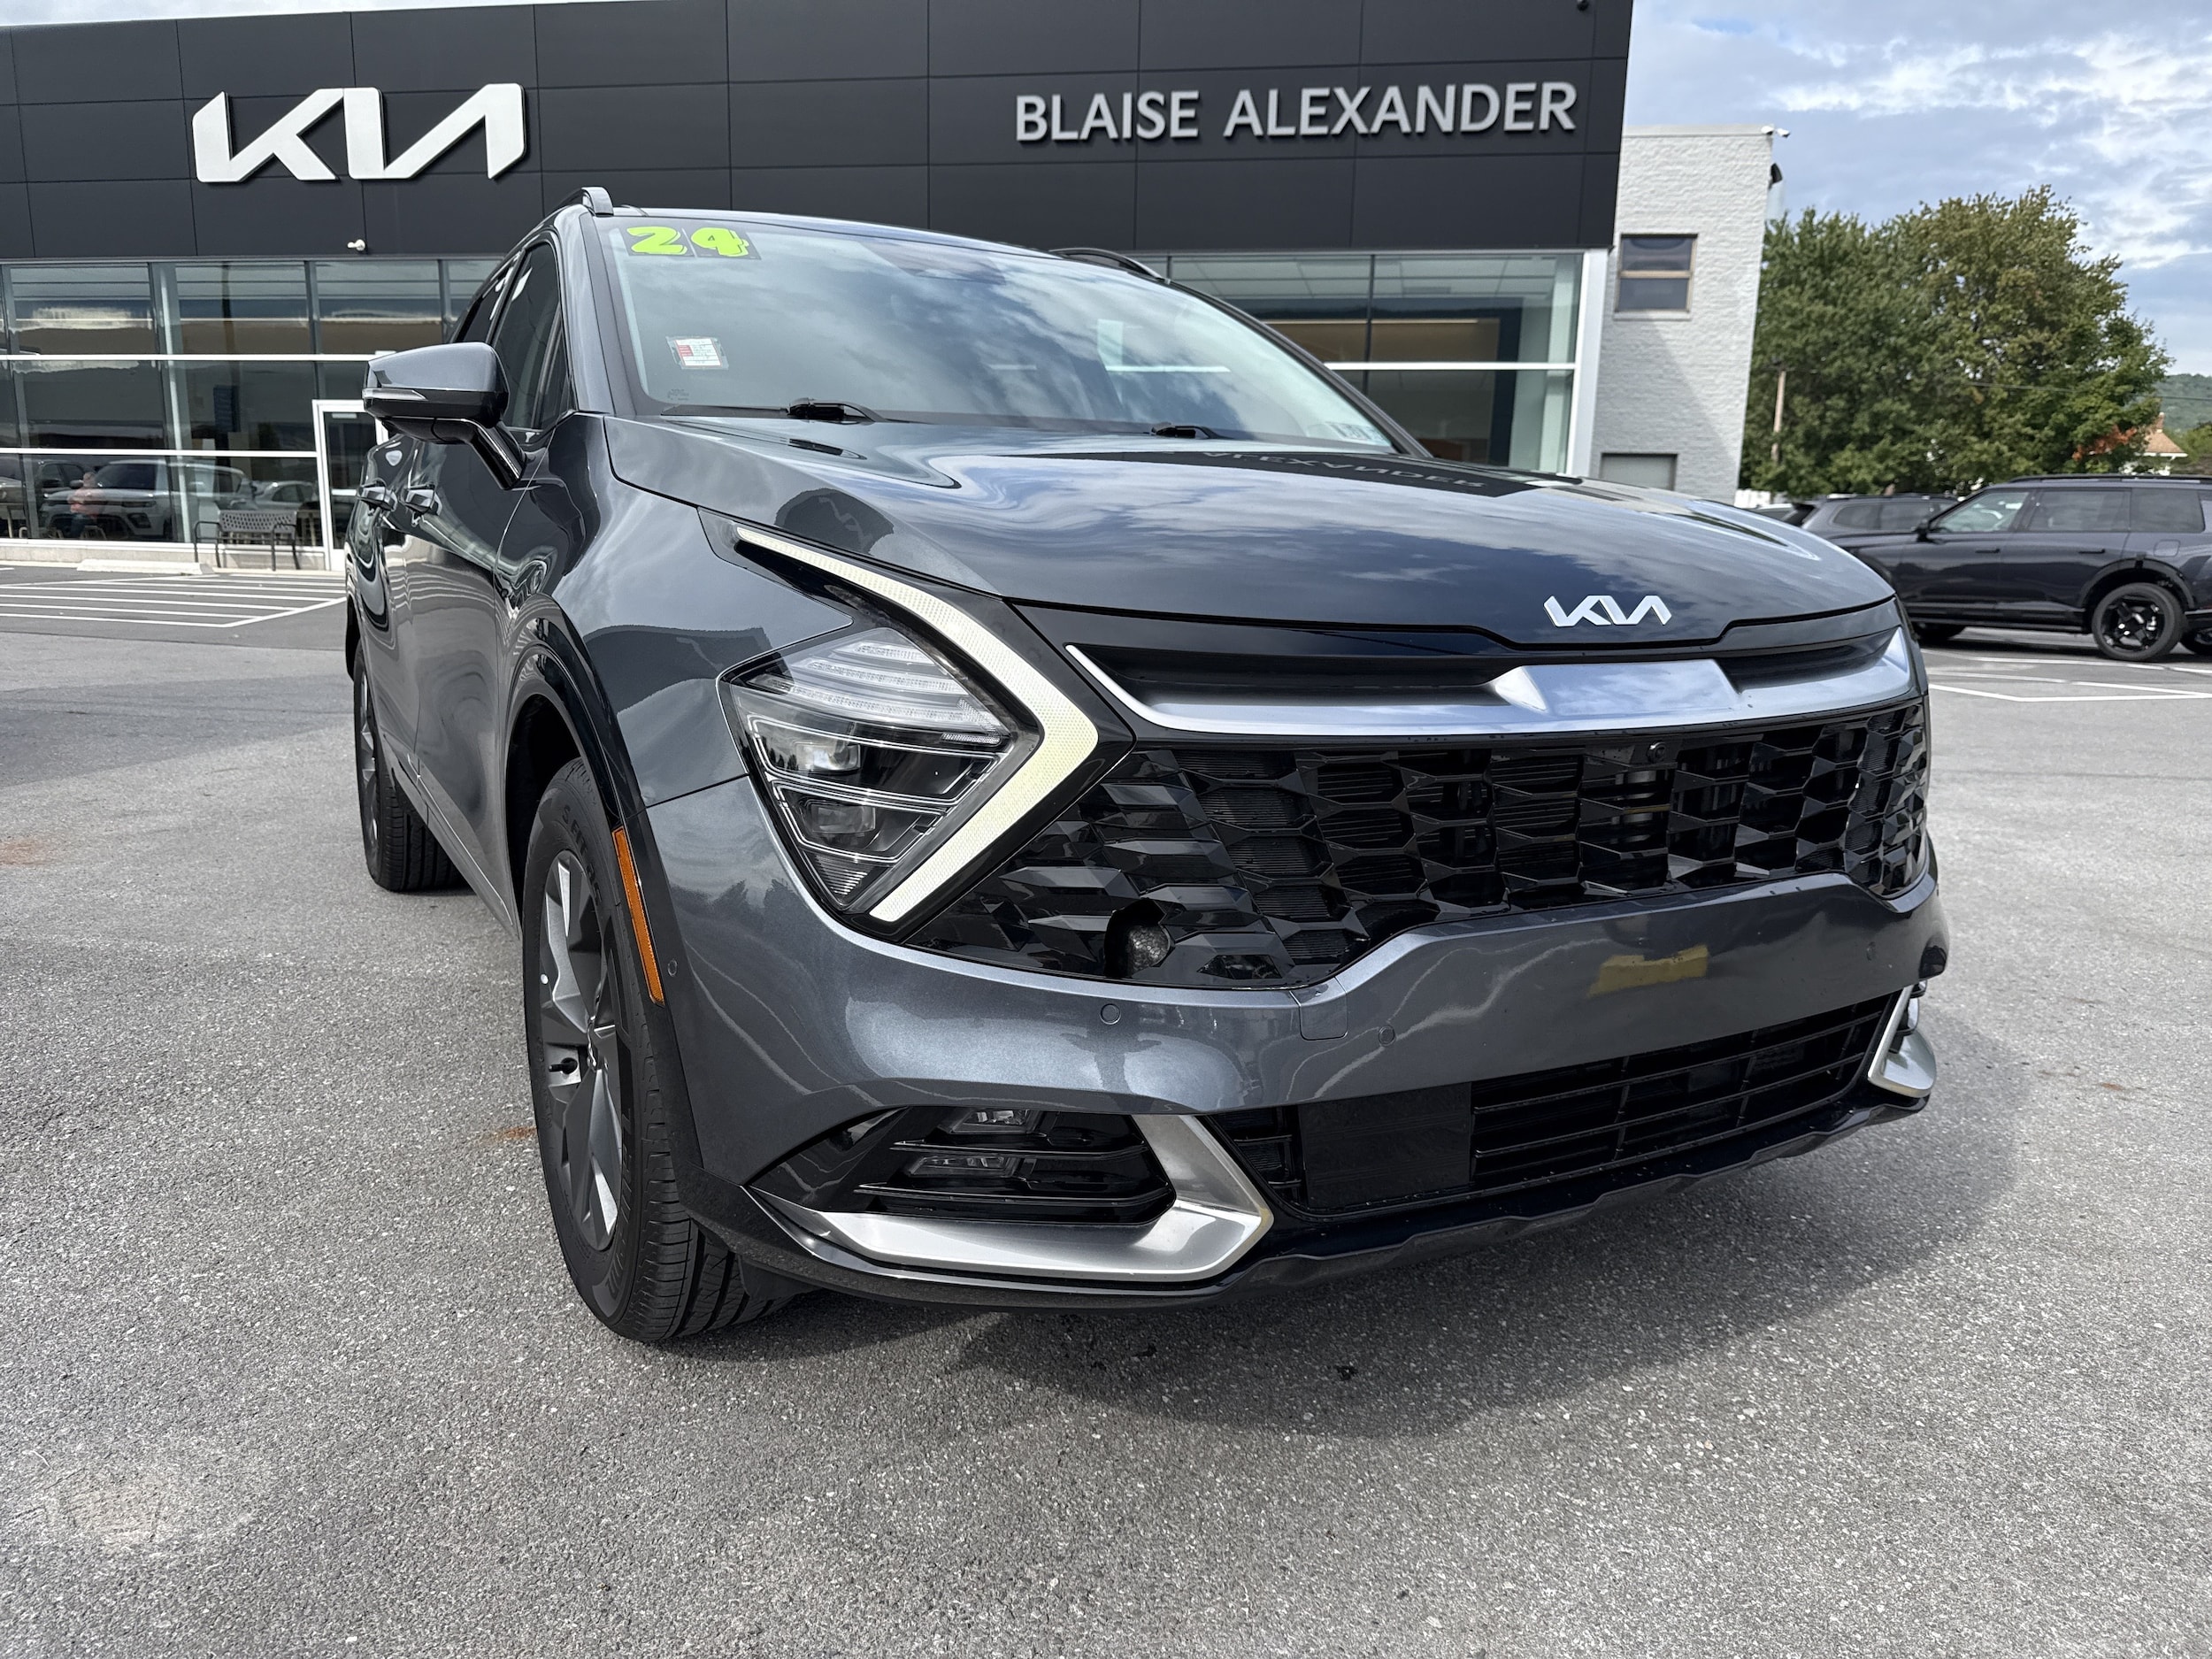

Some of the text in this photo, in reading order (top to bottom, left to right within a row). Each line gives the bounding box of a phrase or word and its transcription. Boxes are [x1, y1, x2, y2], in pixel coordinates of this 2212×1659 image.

[192, 83, 524, 182] KIA
[1017, 82, 1576, 141] BLAISE ALEXANDER
[626, 226, 749, 257] 24
[1543, 594, 1672, 627] KIA
